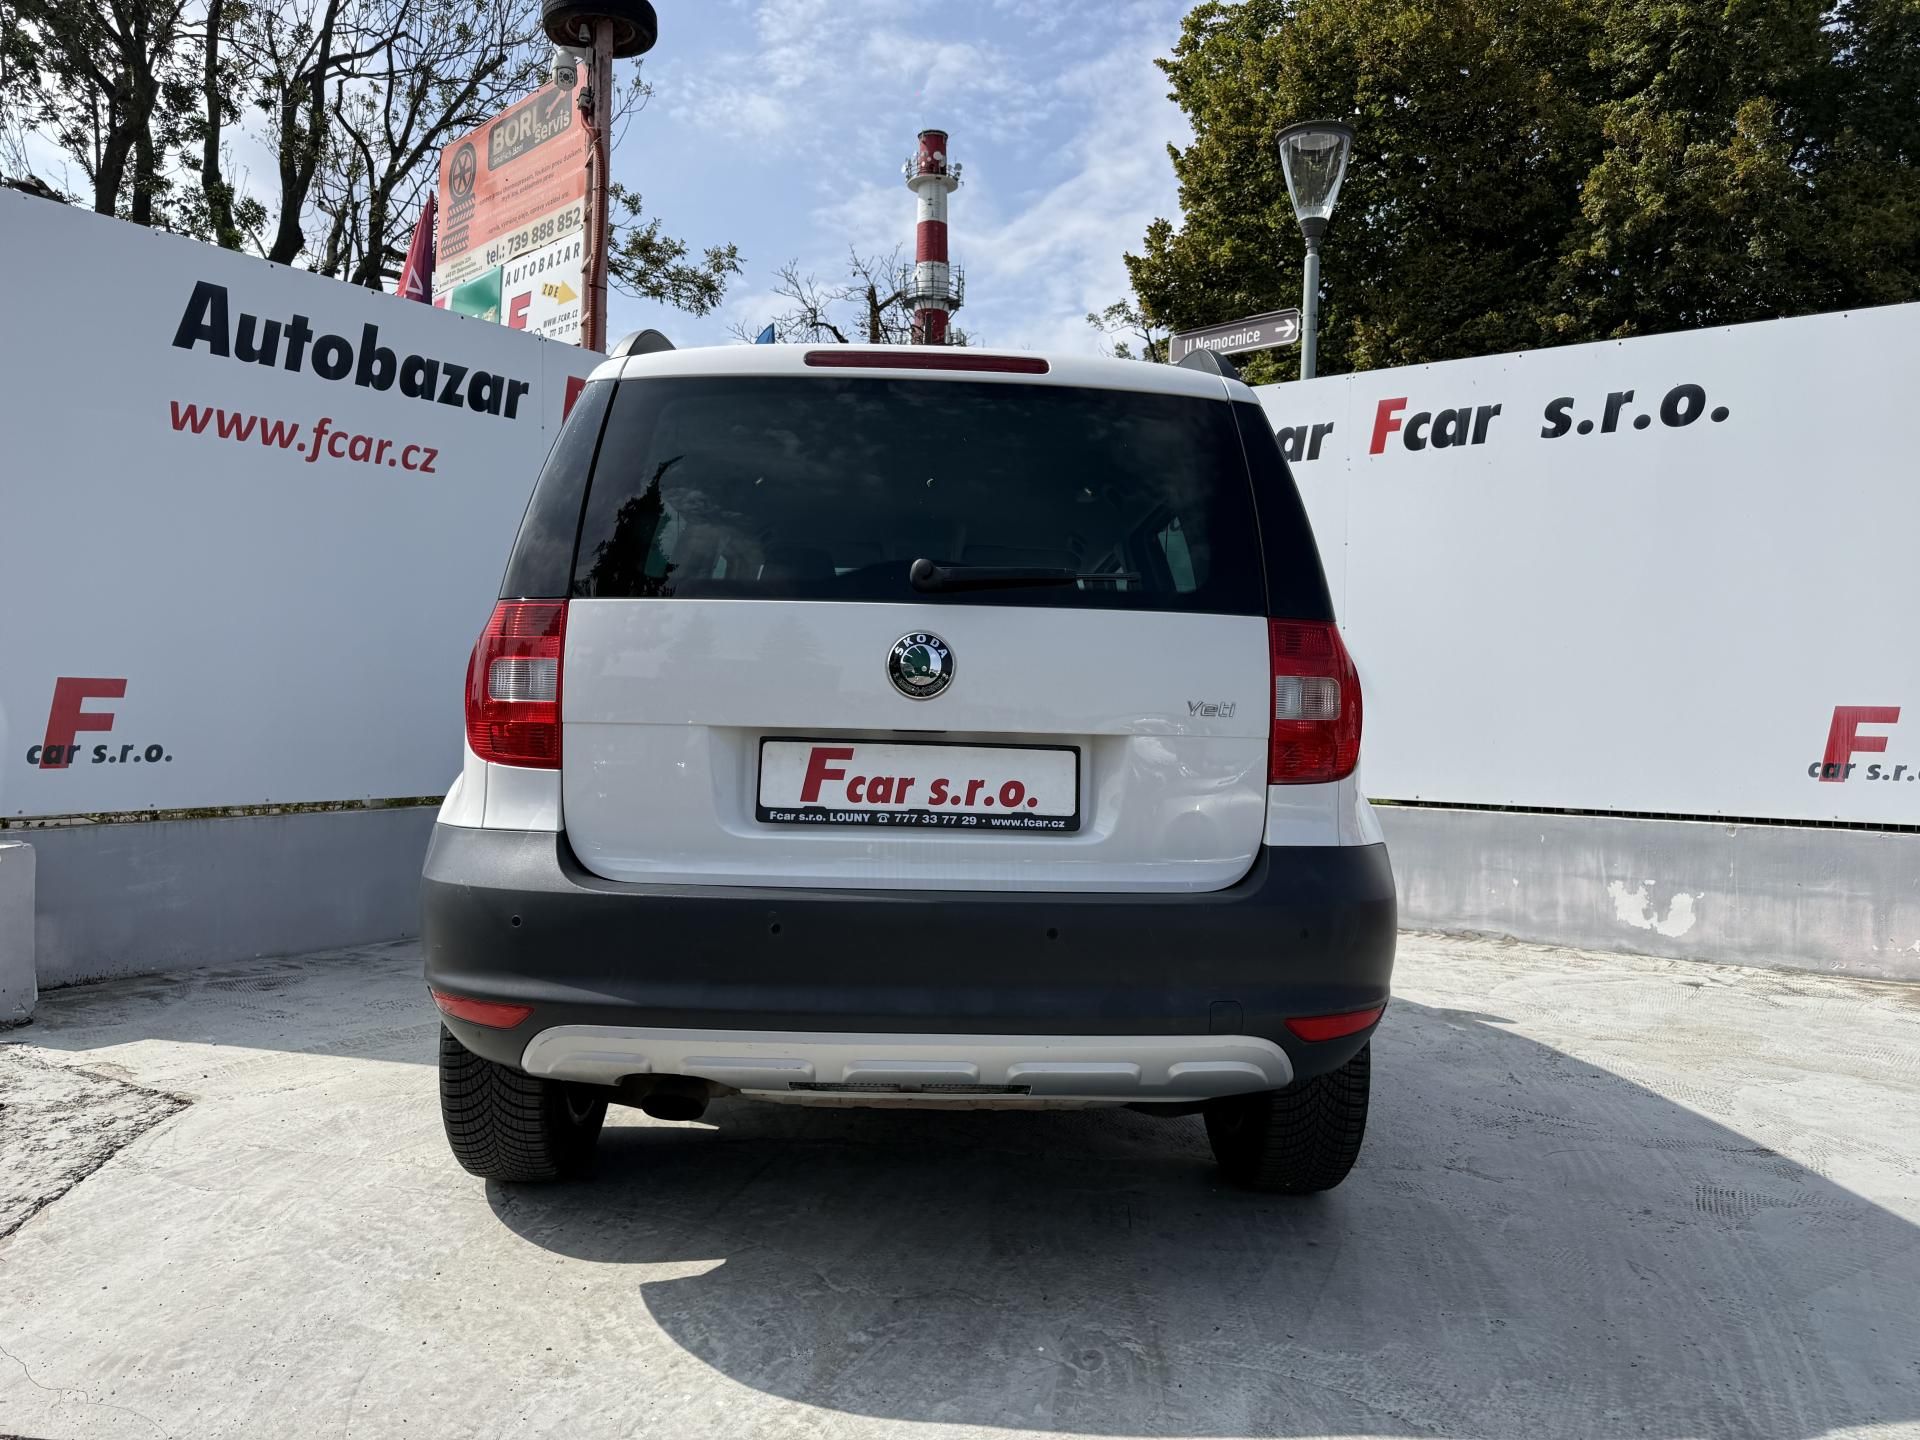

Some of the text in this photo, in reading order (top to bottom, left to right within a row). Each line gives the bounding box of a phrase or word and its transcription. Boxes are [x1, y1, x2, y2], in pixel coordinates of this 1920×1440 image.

[486, 244, 505, 265] tel.:
[508, 231, 528, 256] 739
[531, 219, 555, 244] 888
[557, 206, 581, 232] 852
[505, 241, 580, 287] AUTOBAZAR
[542, 282, 560, 298] ZDE
[172, 280, 529, 419] Autobazar
[1196, 327, 1261, 350] Nemocnice
[1369, 397, 1500, 455] Fcar
[1541, 383, 1730, 440] s.r.o.
[170, 401, 439, 473] www.fcar.cz
[1187, 700, 1236, 718] Yeti
[92, 744, 173, 764] s.r.o.
[800, 747, 1038, 808] Fcar s.r.o.
[1866, 764, 1920, 782] s.r.
[769, 810, 1065, 829] Fcar s.r.o. LOUNY 777 33 77 29 www.fcar.cz
